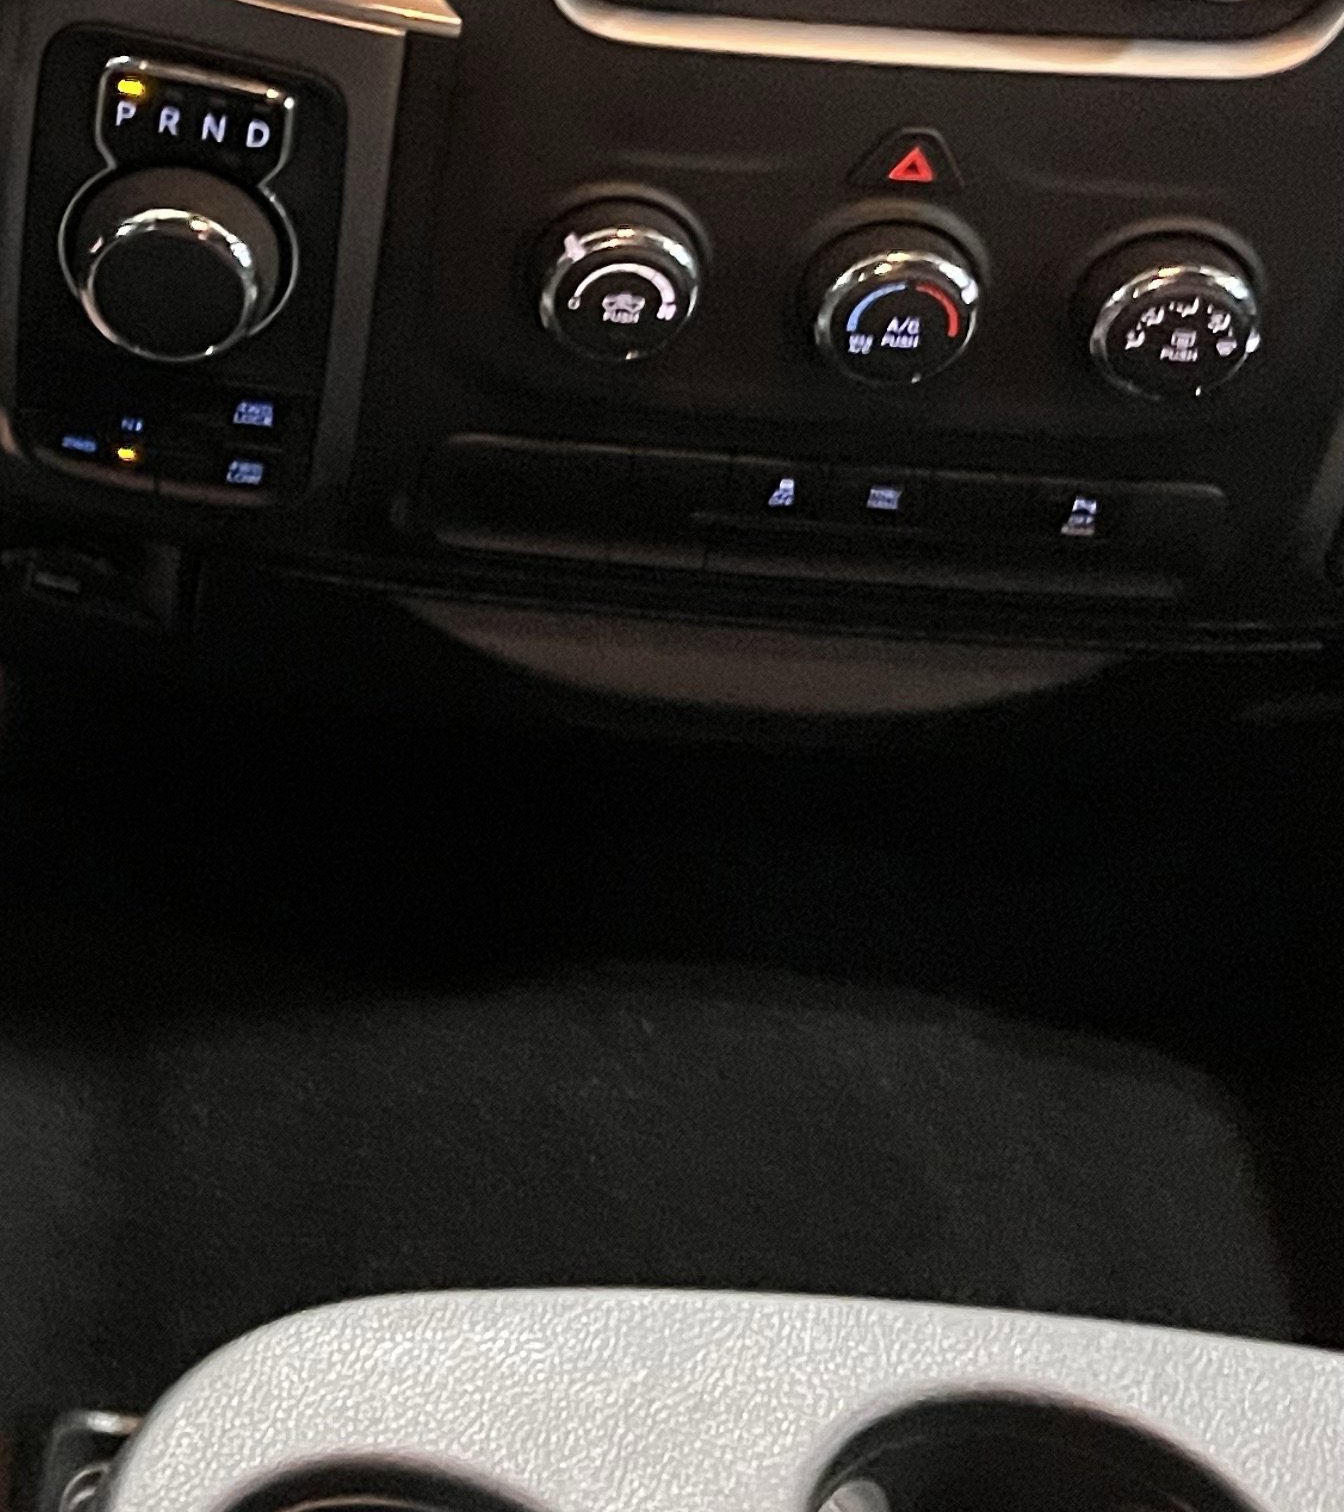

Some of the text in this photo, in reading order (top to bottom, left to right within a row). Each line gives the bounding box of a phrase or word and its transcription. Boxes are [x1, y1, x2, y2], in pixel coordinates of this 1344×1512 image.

[116, 101, 270, 148] P R N D
[887, 316, 920, 335] A/C
